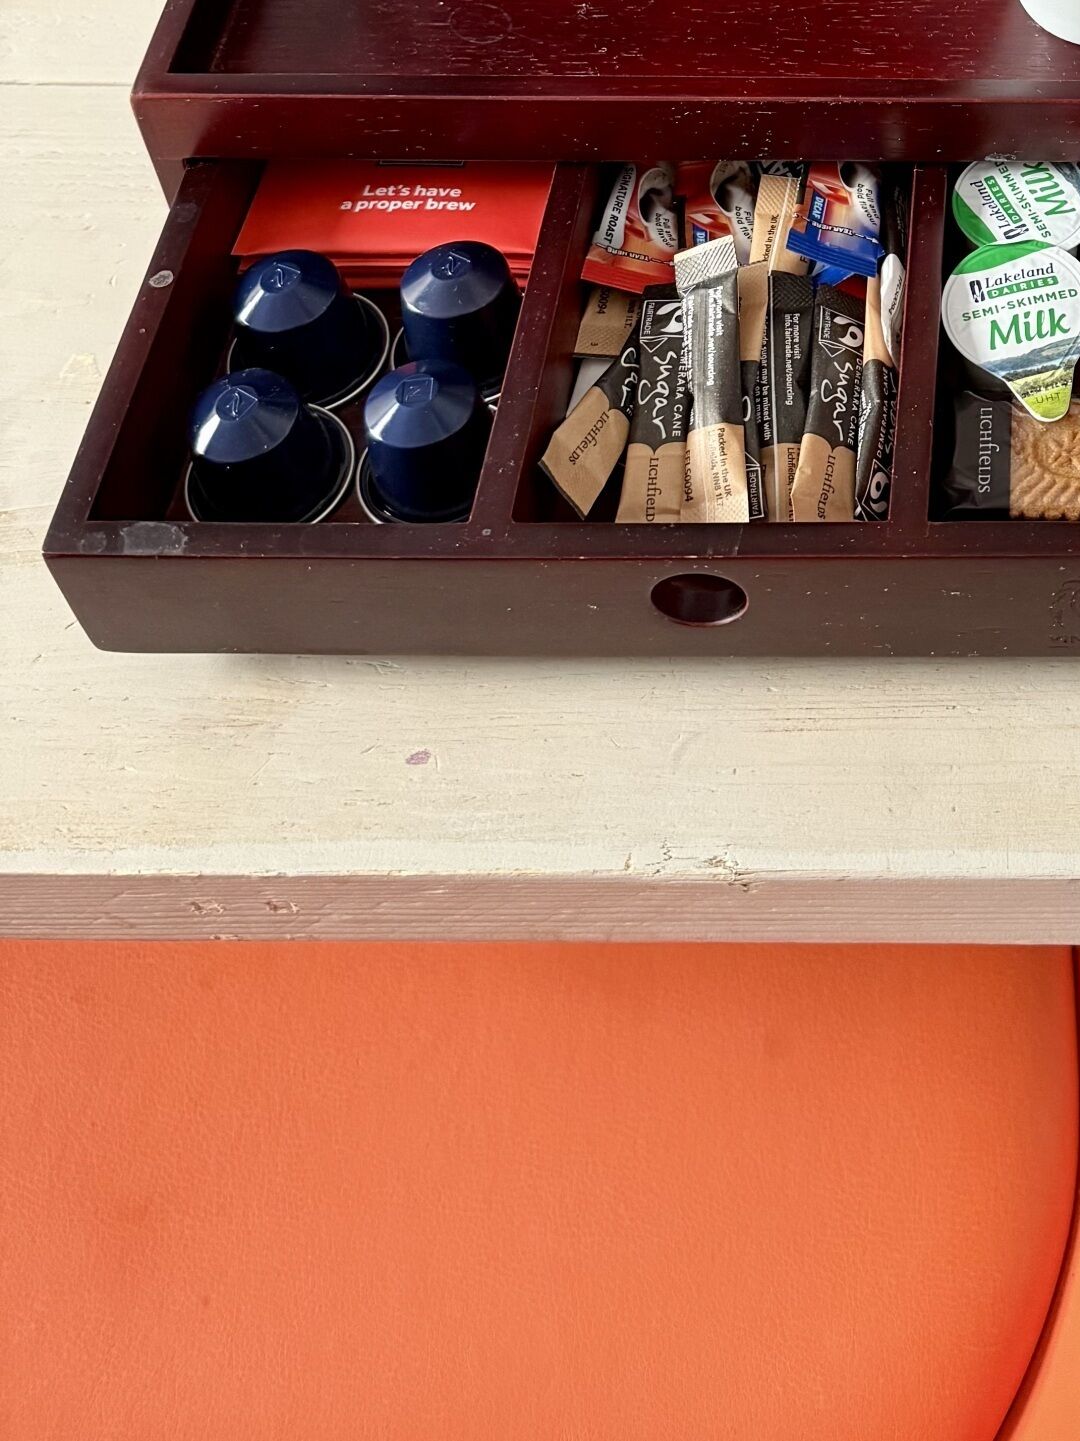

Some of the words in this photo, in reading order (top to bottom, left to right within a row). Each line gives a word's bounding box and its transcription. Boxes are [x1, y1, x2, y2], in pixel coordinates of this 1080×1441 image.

[362, 185, 411, 197] Let's
[413, 185, 462, 197] have
[612, 166, 634, 214] SIGNATURE
[857, 183, 865, 199] bold
[865, 188, 875, 203] Full
[1020, 162, 1077, 217] Milk
[340, 200, 352, 210] a
[353, 199, 423, 212] proper
[424, 198, 476, 211] brew
[812, 195, 825, 221] DECAF
[969, 179, 1007, 229] Lakeland
[986, 179, 1020, 222] DAIRIES
[735, 205, 745, 225] bold
[744, 210, 754, 226] Full
[859, 200, 878, 226] flavour
[869, 204, 880, 219] and
[603, 214, 619, 244] ROAST
[739, 226, 753, 241] flav
[767, 224, 776, 235] the
[811, 220, 832, 230] HERE
[833, 226, 853, 236] TEAR
[984, 262, 1055, 289] Lakeland
[990, 277, 1055, 297] DAIRIES
[962, 288, 1078, 322] SEMI-SKIMMED
[643, 301, 655, 335] FAIRTRADE
[715, 319, 724, 337] visit
[989, 307, 1071, 351] Milk
[760, 346, 768, 367] sugar
[784, 313, 795, 406] info.fairtrade.net/sourcing
[793, 343, 801, 360] visit
[761, 368, 769, 385] may
[849, 357, 864, 409] DEMERARA
[762, 385, 770, 396] be
[1035, 392, 1061, 404] UHT
[762, 397, 772, 421] mixed
[672, 404, 683, 437] CANE
[847, 409, 859, 446] CANE
[876, 399, 889, 459] DEMERARA
[763, 421, 771, 441] with
[717, 427, 727, 457] Packed
[720, 458, 727, 467] in
[721, 469, 729, 483] the
[750, 471, 759, 515] FAIRTRADE
